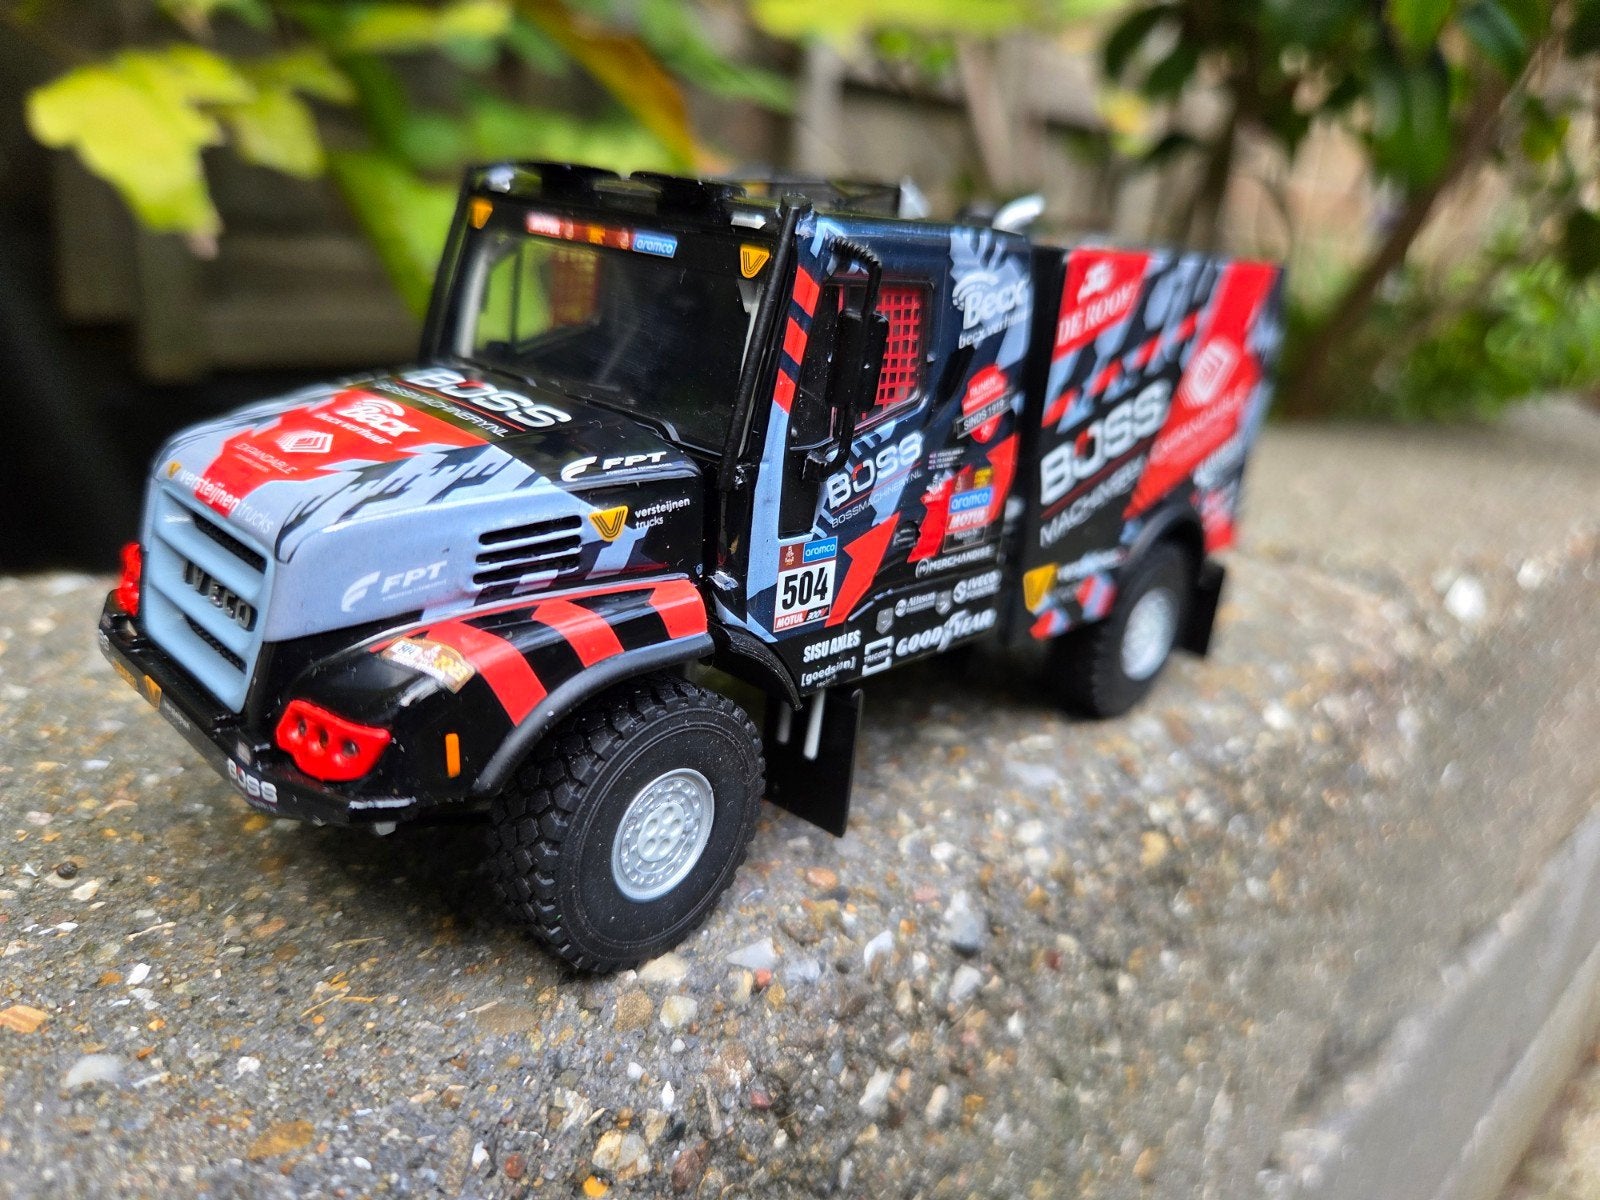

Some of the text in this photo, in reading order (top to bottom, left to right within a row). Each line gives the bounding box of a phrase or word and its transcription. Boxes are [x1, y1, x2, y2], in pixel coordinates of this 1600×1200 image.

[636, 237, 673, 252] aramco
[403, 367, 573, 428] BOSS
[1040, 378, 1172, 505] BOSS
[602, 451, 667, 470] FPT
[826, 433, 923, 510] BOSS
[179, 469, 241, 513] versteijnen
[951, 491, 989, 511] aramco
[634, 497, 690, 518] versteijnen
[635, 516, 664, 531] trucks
[805, 543, 835, 557] aramco
[380, 560, 448, 594] FPT
[781, 566, 828, 610] 504
[776, 613, 804, 629] MOTUL
[895, 608, 997, 657] GOODYEAR
[803, 640, 830, 663] SISU
[227, 757, 278, 804] BOSS
